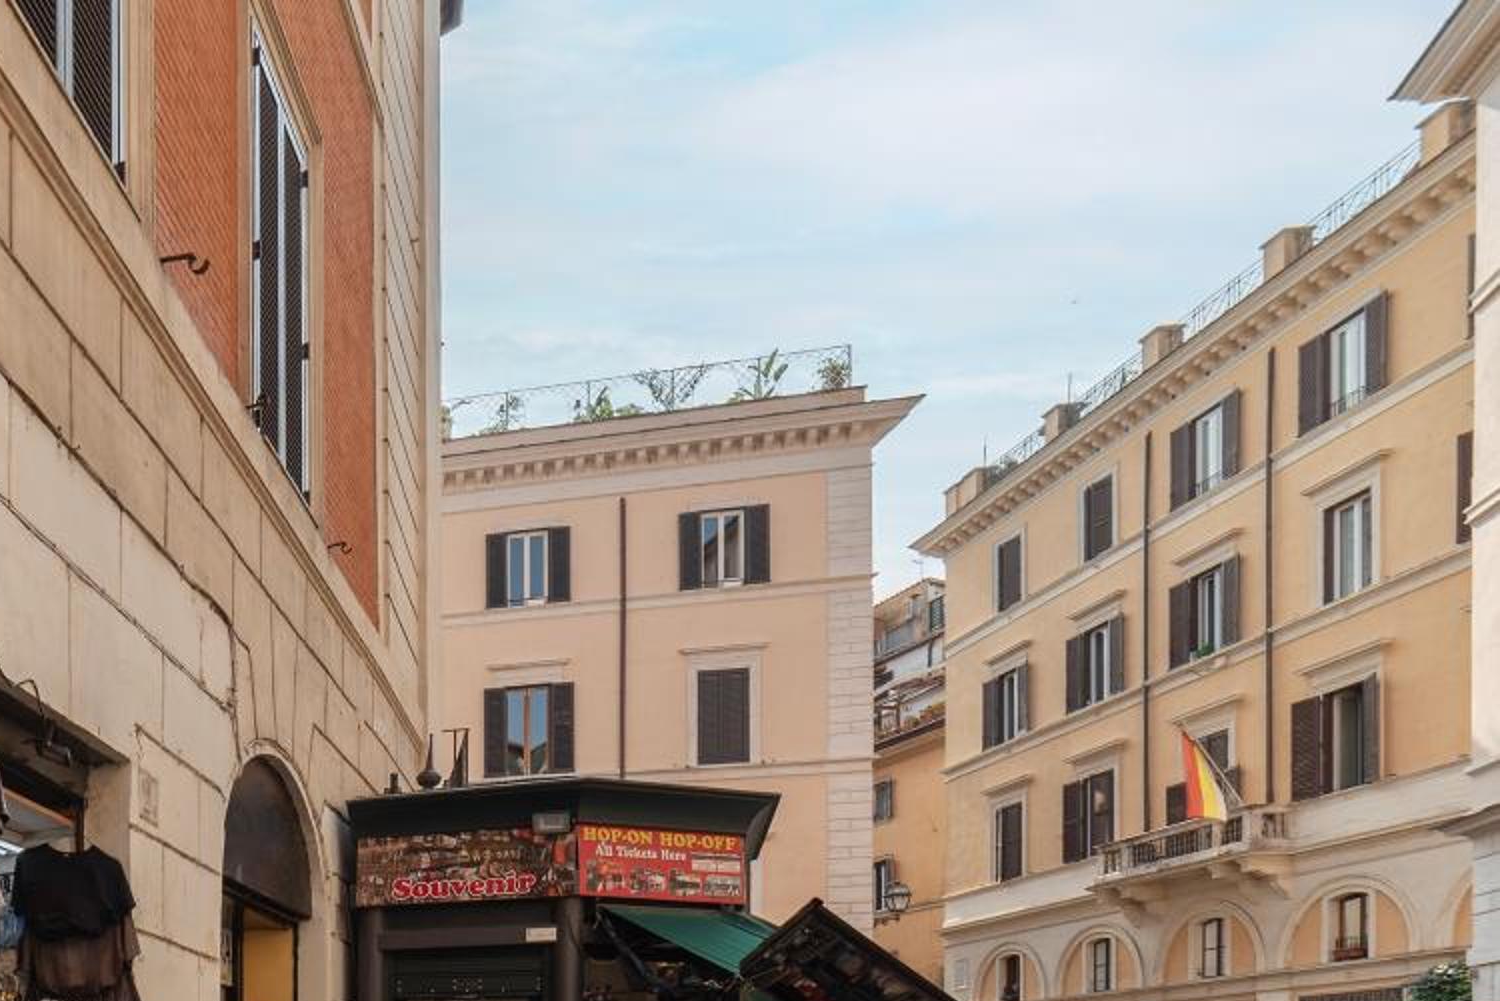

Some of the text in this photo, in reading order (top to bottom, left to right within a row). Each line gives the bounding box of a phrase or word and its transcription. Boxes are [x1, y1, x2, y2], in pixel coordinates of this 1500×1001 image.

[582, 826, 737, 851] HOP-ON HOP-OFF
[595, 842, 687, 862] All Tickets Here
[392, 869, 537, 899] Souvenir
